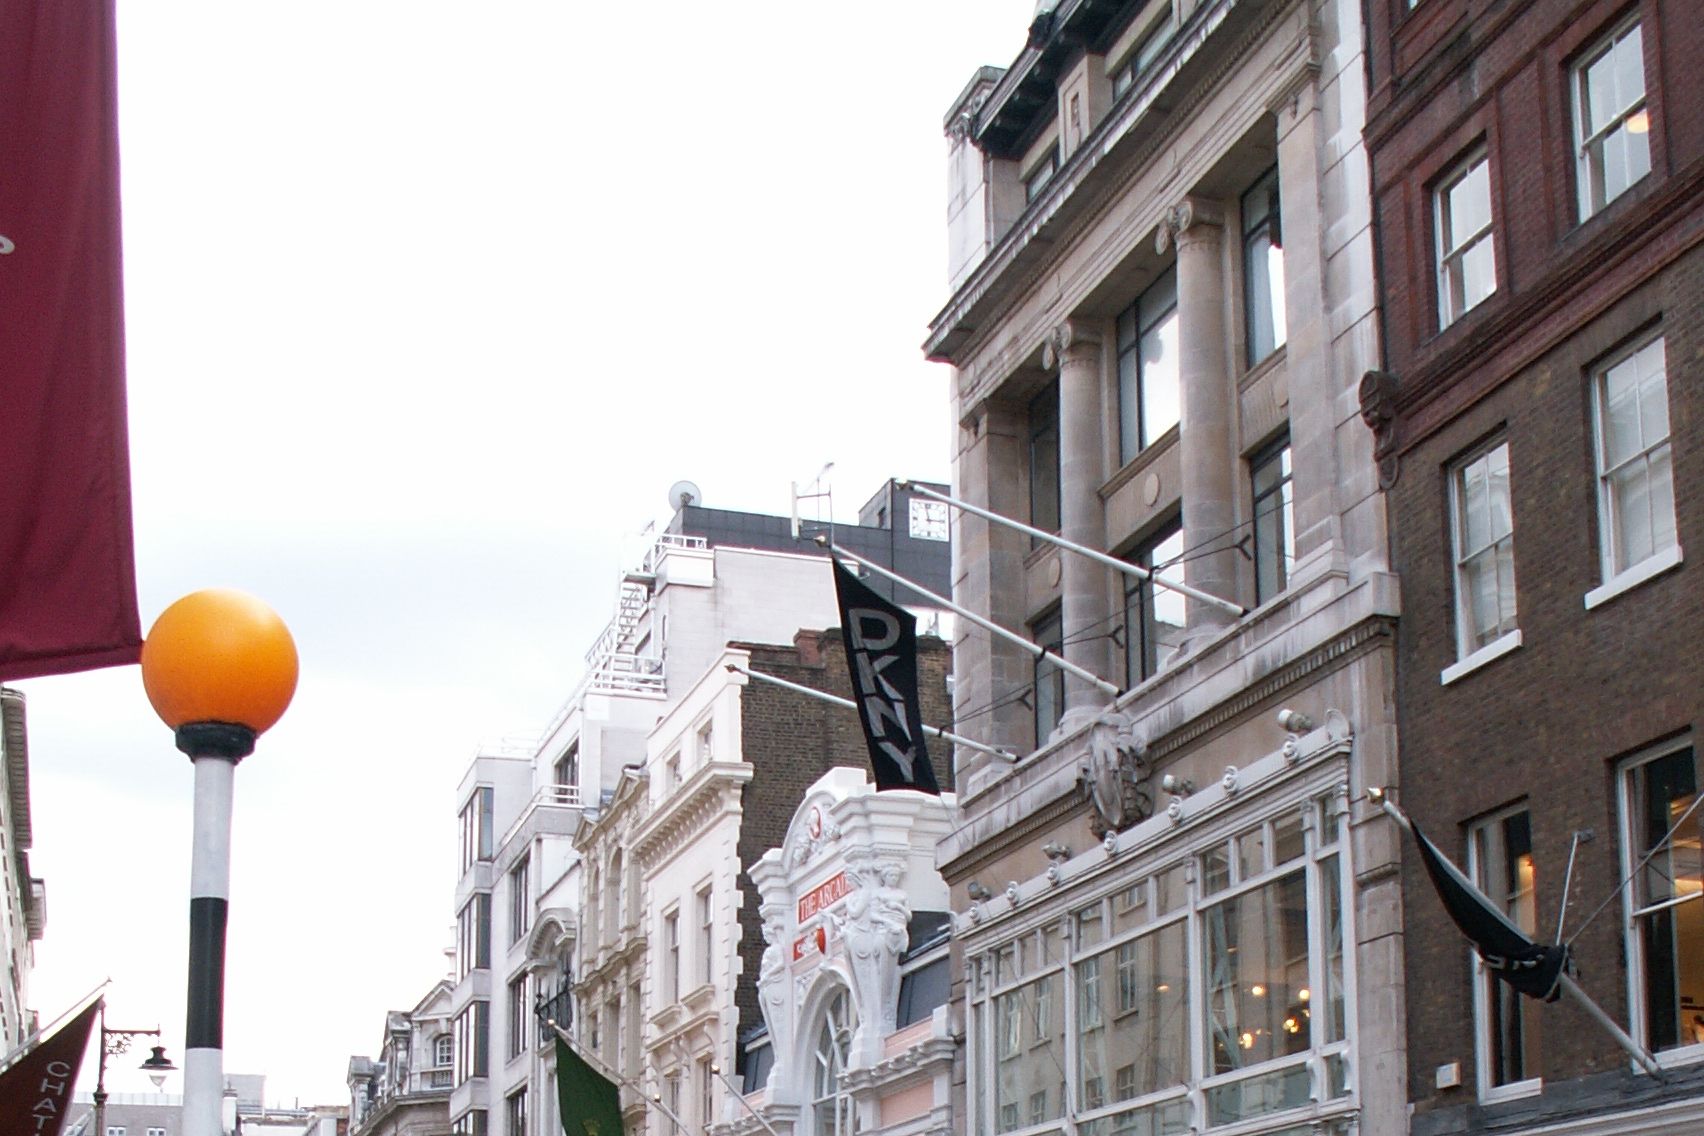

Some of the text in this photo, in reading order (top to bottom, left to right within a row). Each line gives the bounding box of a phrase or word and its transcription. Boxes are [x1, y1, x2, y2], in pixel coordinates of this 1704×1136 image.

[849, 608, 917, 783] DKNY
[800, 875, 848, 921] THE ARCAD
